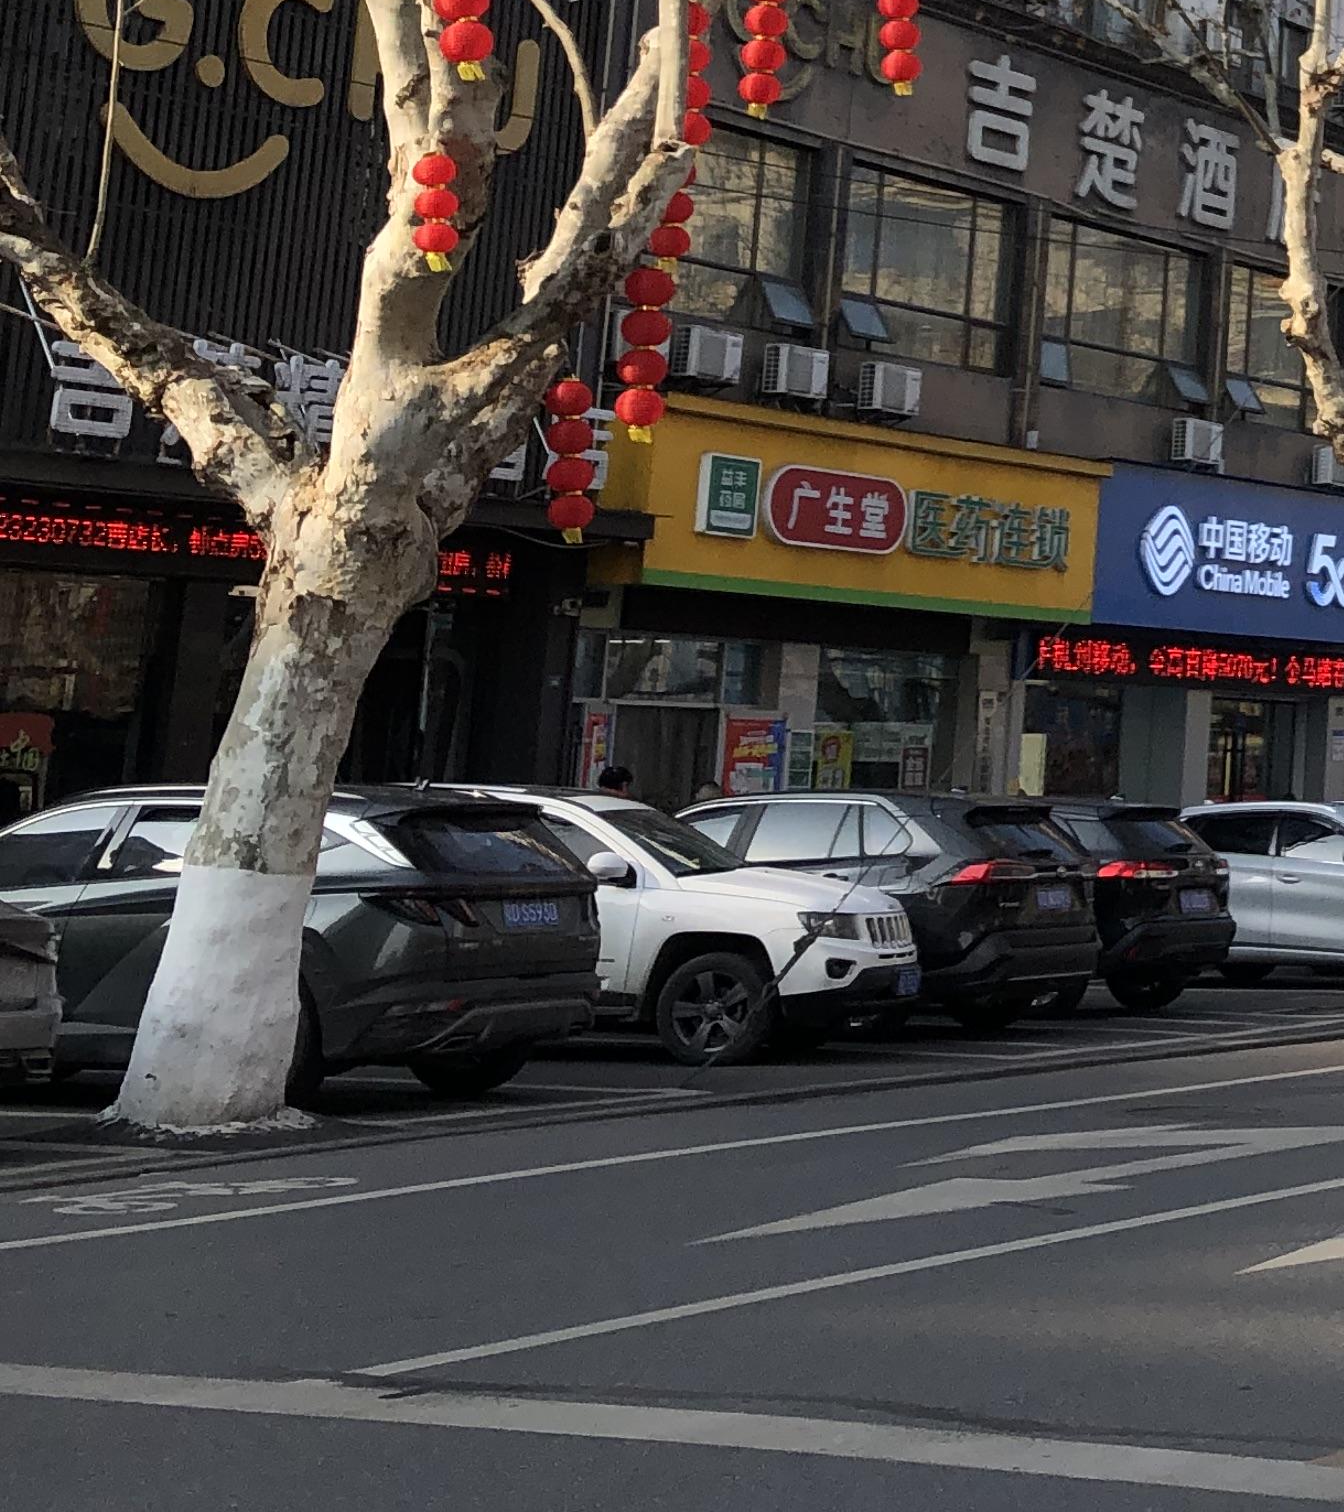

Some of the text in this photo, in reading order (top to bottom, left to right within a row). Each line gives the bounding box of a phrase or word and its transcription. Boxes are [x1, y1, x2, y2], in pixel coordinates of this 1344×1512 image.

[787, 482, 890, 539] 广生堂
[911, 490, 1070, 572] 医药连锁
[1199, 516, 1293, 566] 中国移动
